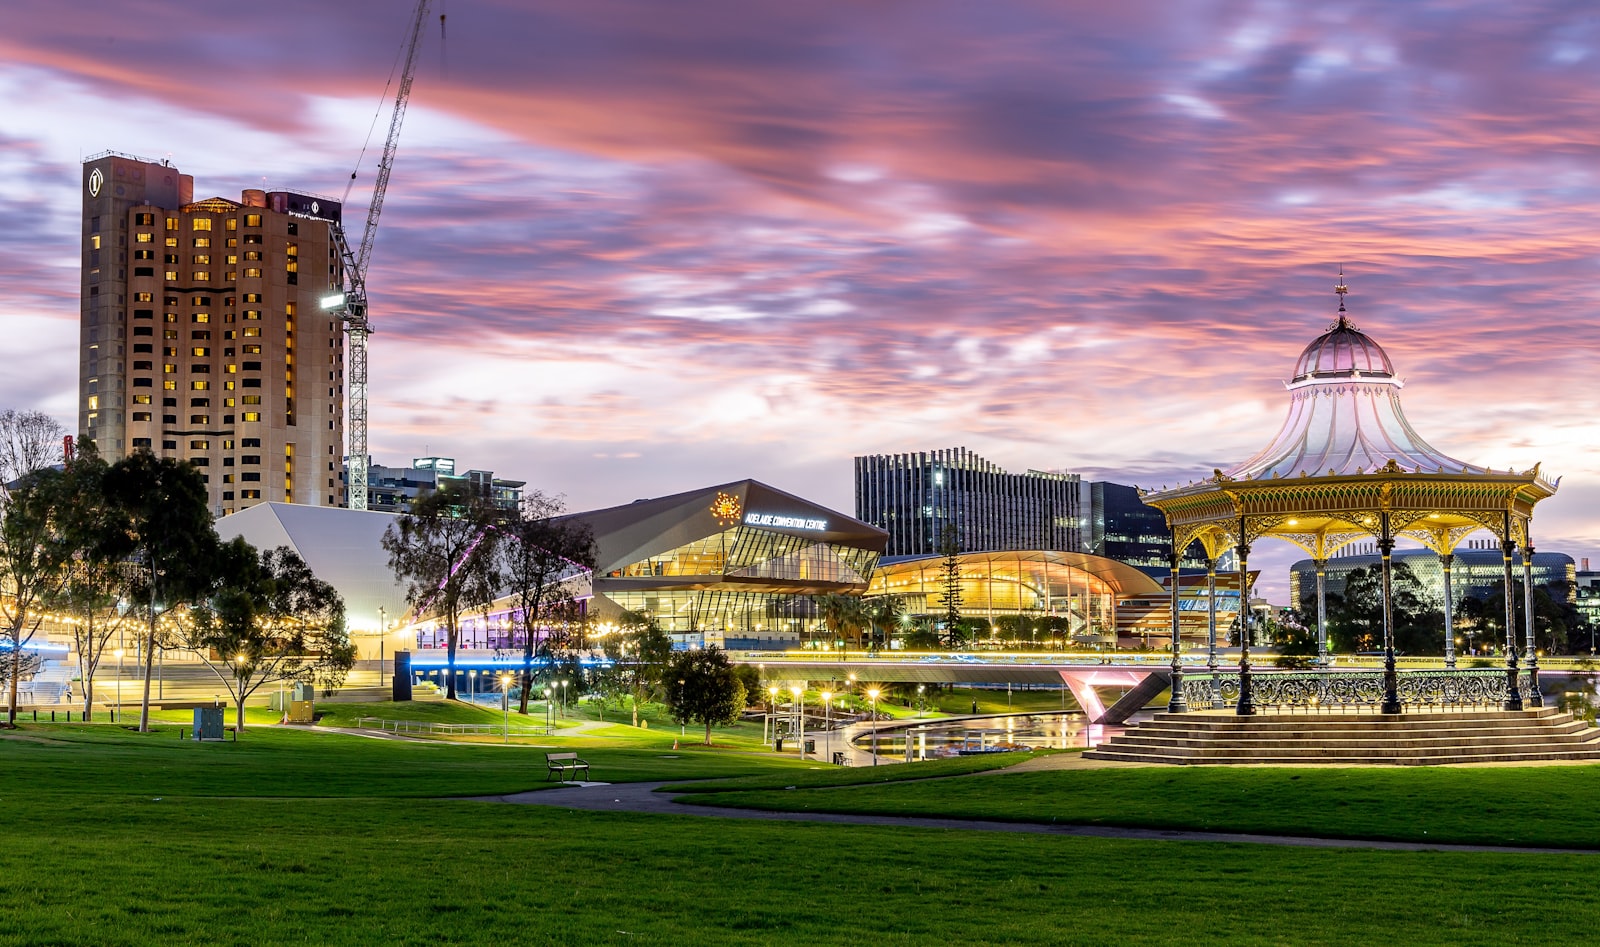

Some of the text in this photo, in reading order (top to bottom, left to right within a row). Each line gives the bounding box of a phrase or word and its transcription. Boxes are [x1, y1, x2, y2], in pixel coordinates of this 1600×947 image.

[745, 513, 827, 531] ADELAIDE CONVENTION CENTRE
